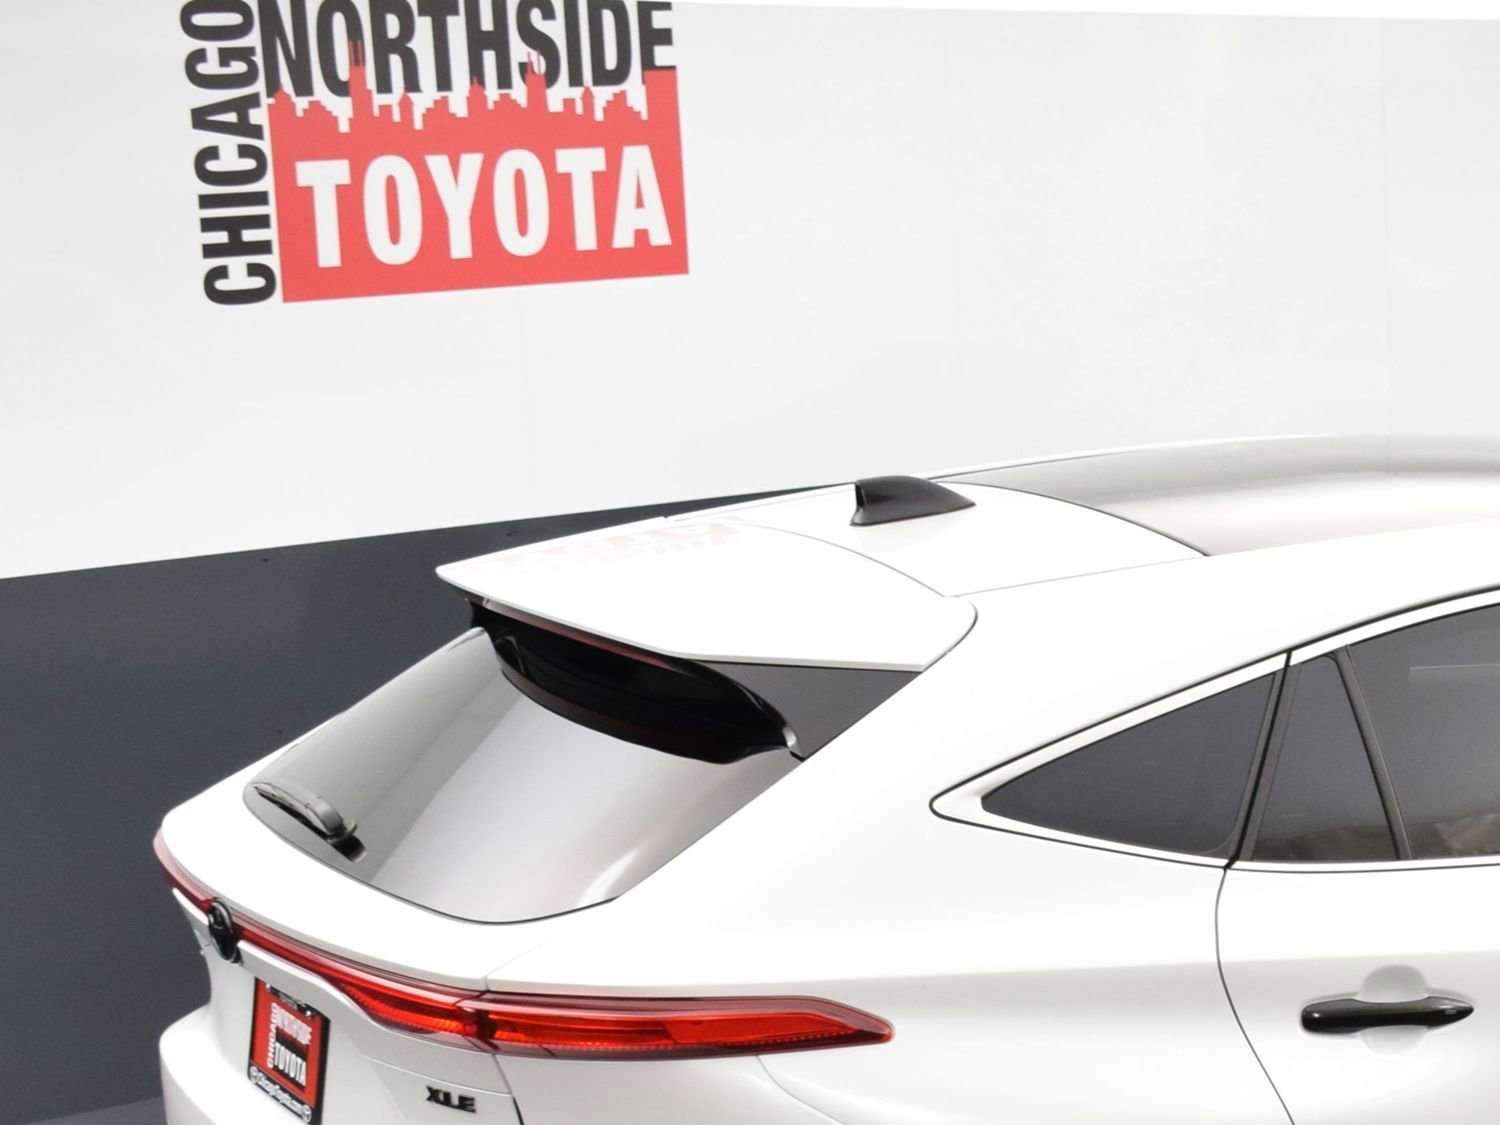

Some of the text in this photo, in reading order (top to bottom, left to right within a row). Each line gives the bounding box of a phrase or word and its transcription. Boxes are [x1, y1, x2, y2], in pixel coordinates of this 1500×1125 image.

[257, 0, 676, 98] NORTHSIDE
[180, 0, 275, 305] CHICAGO
[296, 145, 672, 268] TOYOTA
[274, 1041, 307, 1087] TOYOTA
[426, 1085, 477, 1114] XLE
